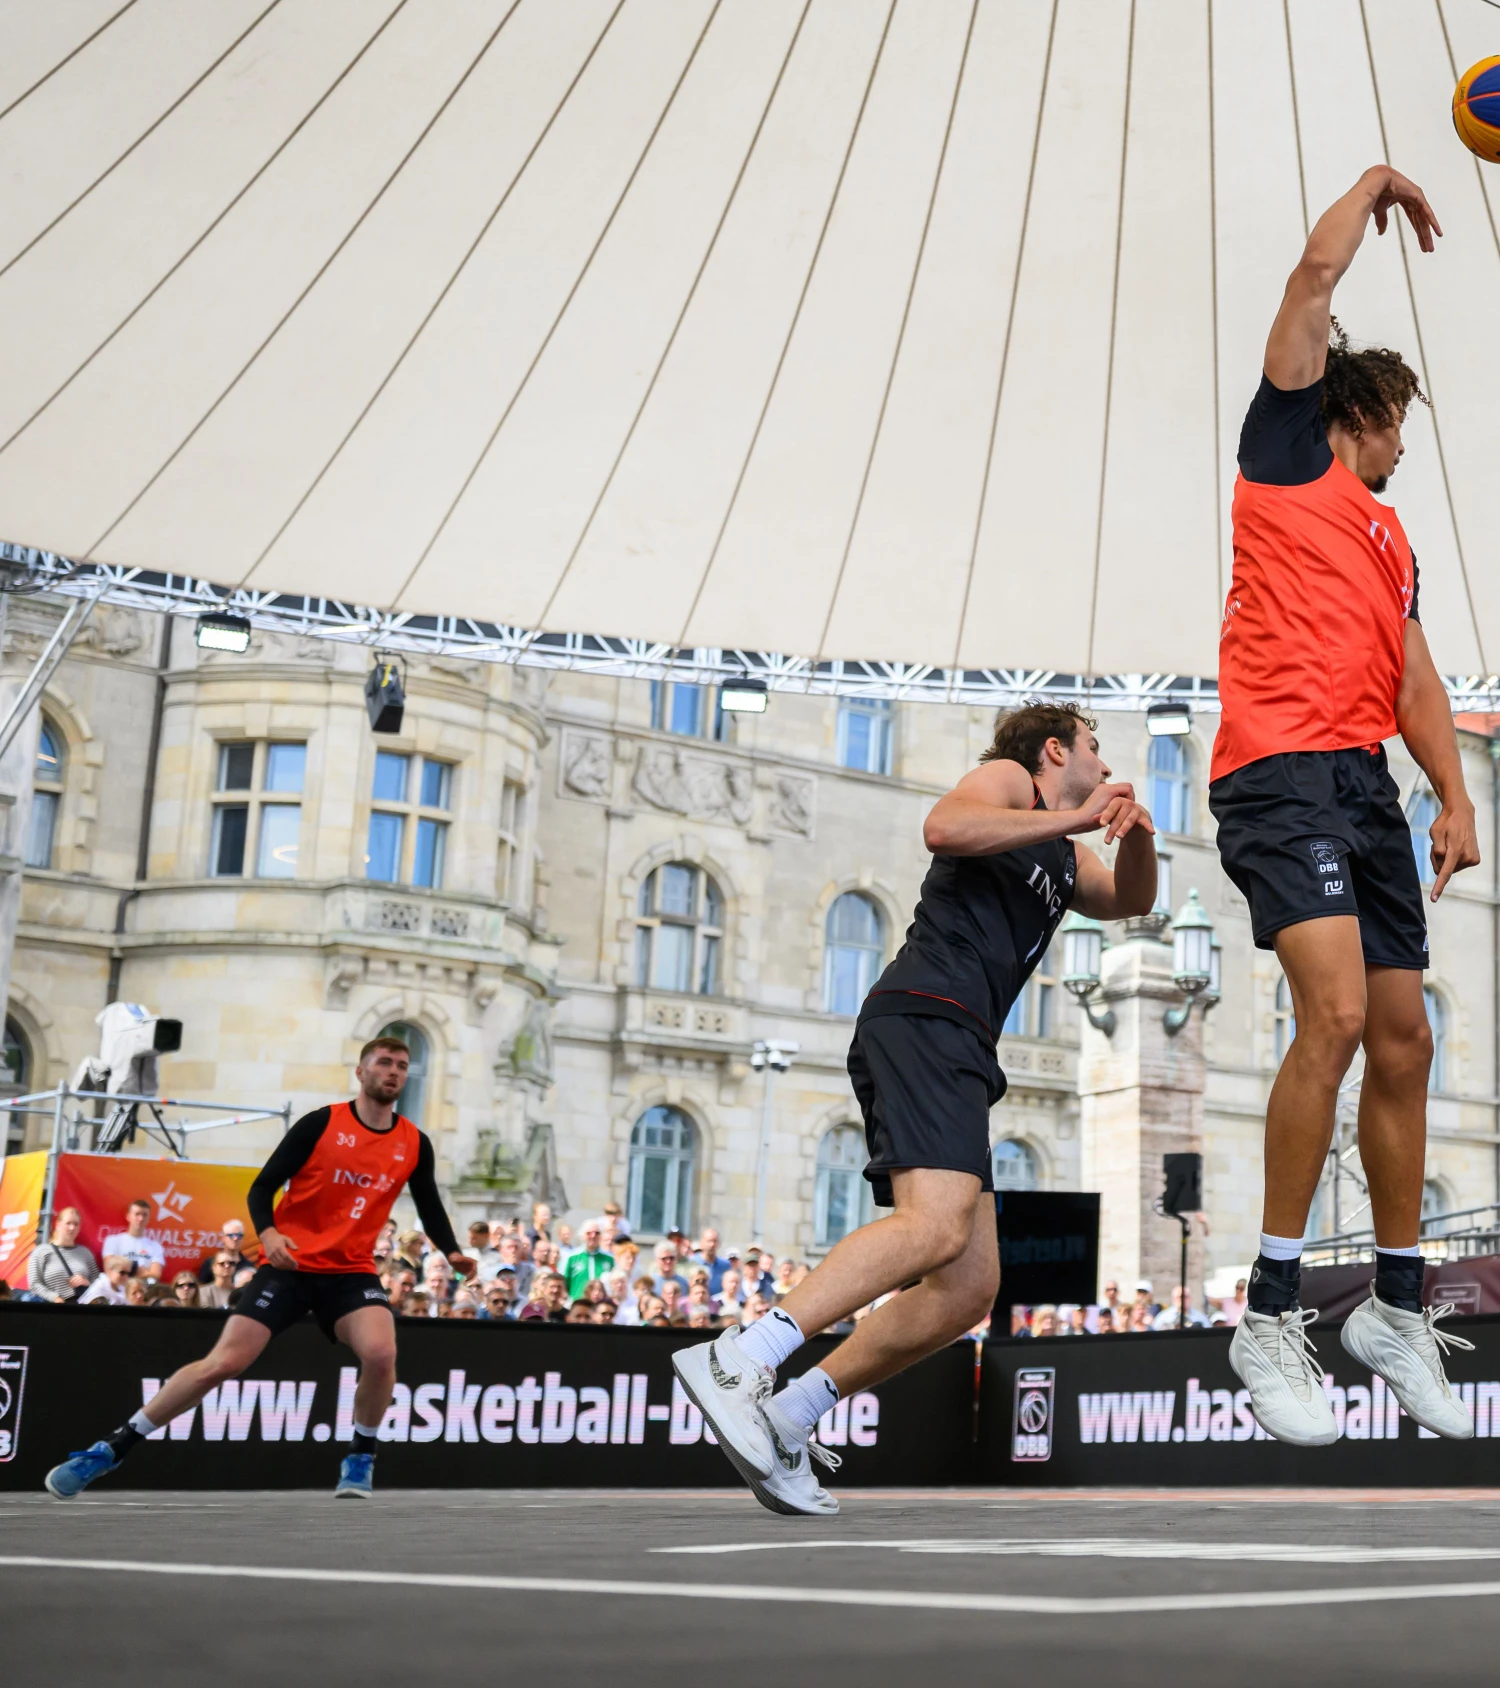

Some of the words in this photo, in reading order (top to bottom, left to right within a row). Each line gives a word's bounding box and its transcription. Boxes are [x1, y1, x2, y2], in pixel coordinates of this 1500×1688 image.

[1319, 862, 1338, 873] DBB
[1025, 863, 1062, 918] ING
[333, 1169, 372, 1188] ING
[350, 1197, 366, 1219] 2
